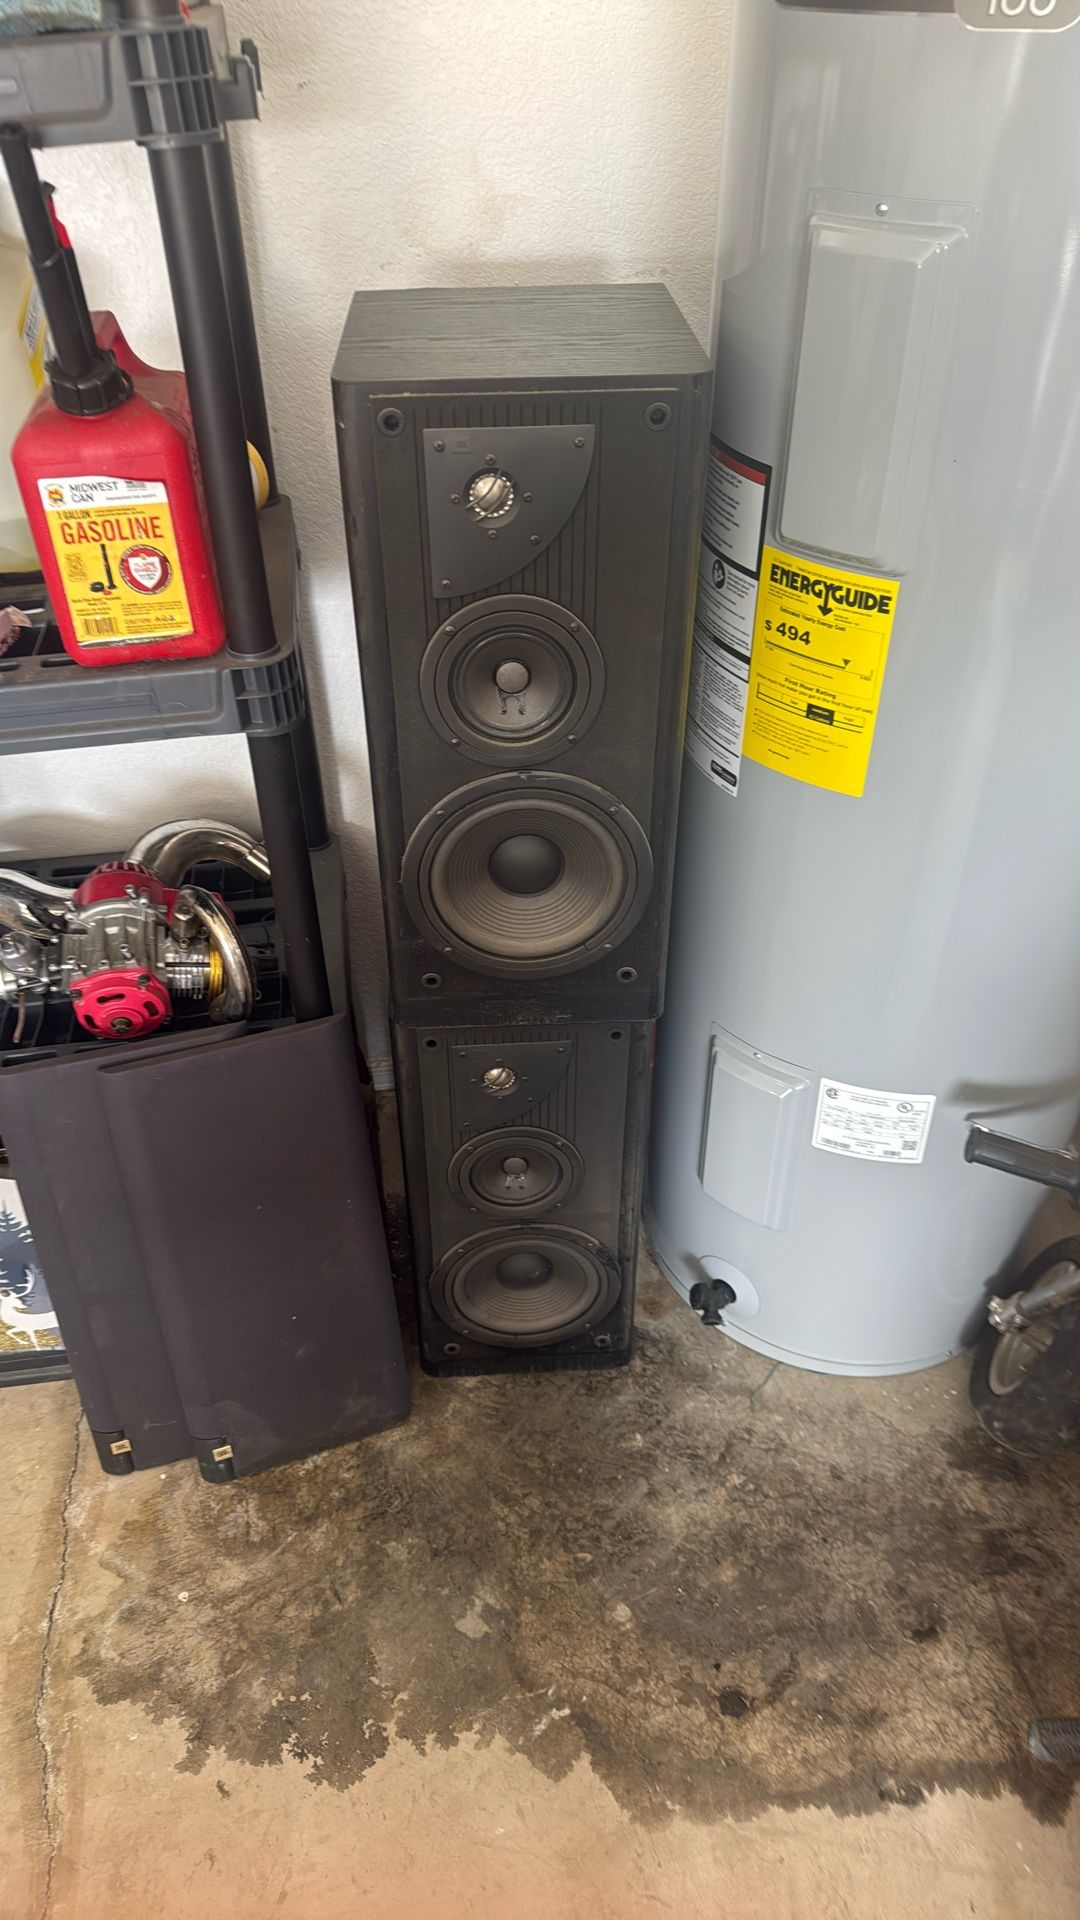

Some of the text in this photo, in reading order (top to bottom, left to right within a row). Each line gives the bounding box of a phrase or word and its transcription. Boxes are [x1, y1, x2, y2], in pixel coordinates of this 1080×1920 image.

[68, 481, 119, 492] MIDWEST
[71, 493, 95, 503] CAN
[60, 516, 164, 544] GASOLINE
[769, 563, 892, 615] ENERGYGUIDE
[776, 622, 811, 646] 494
[784, 677, 799, 687] First
[815, 688, 837, 699] Rating
